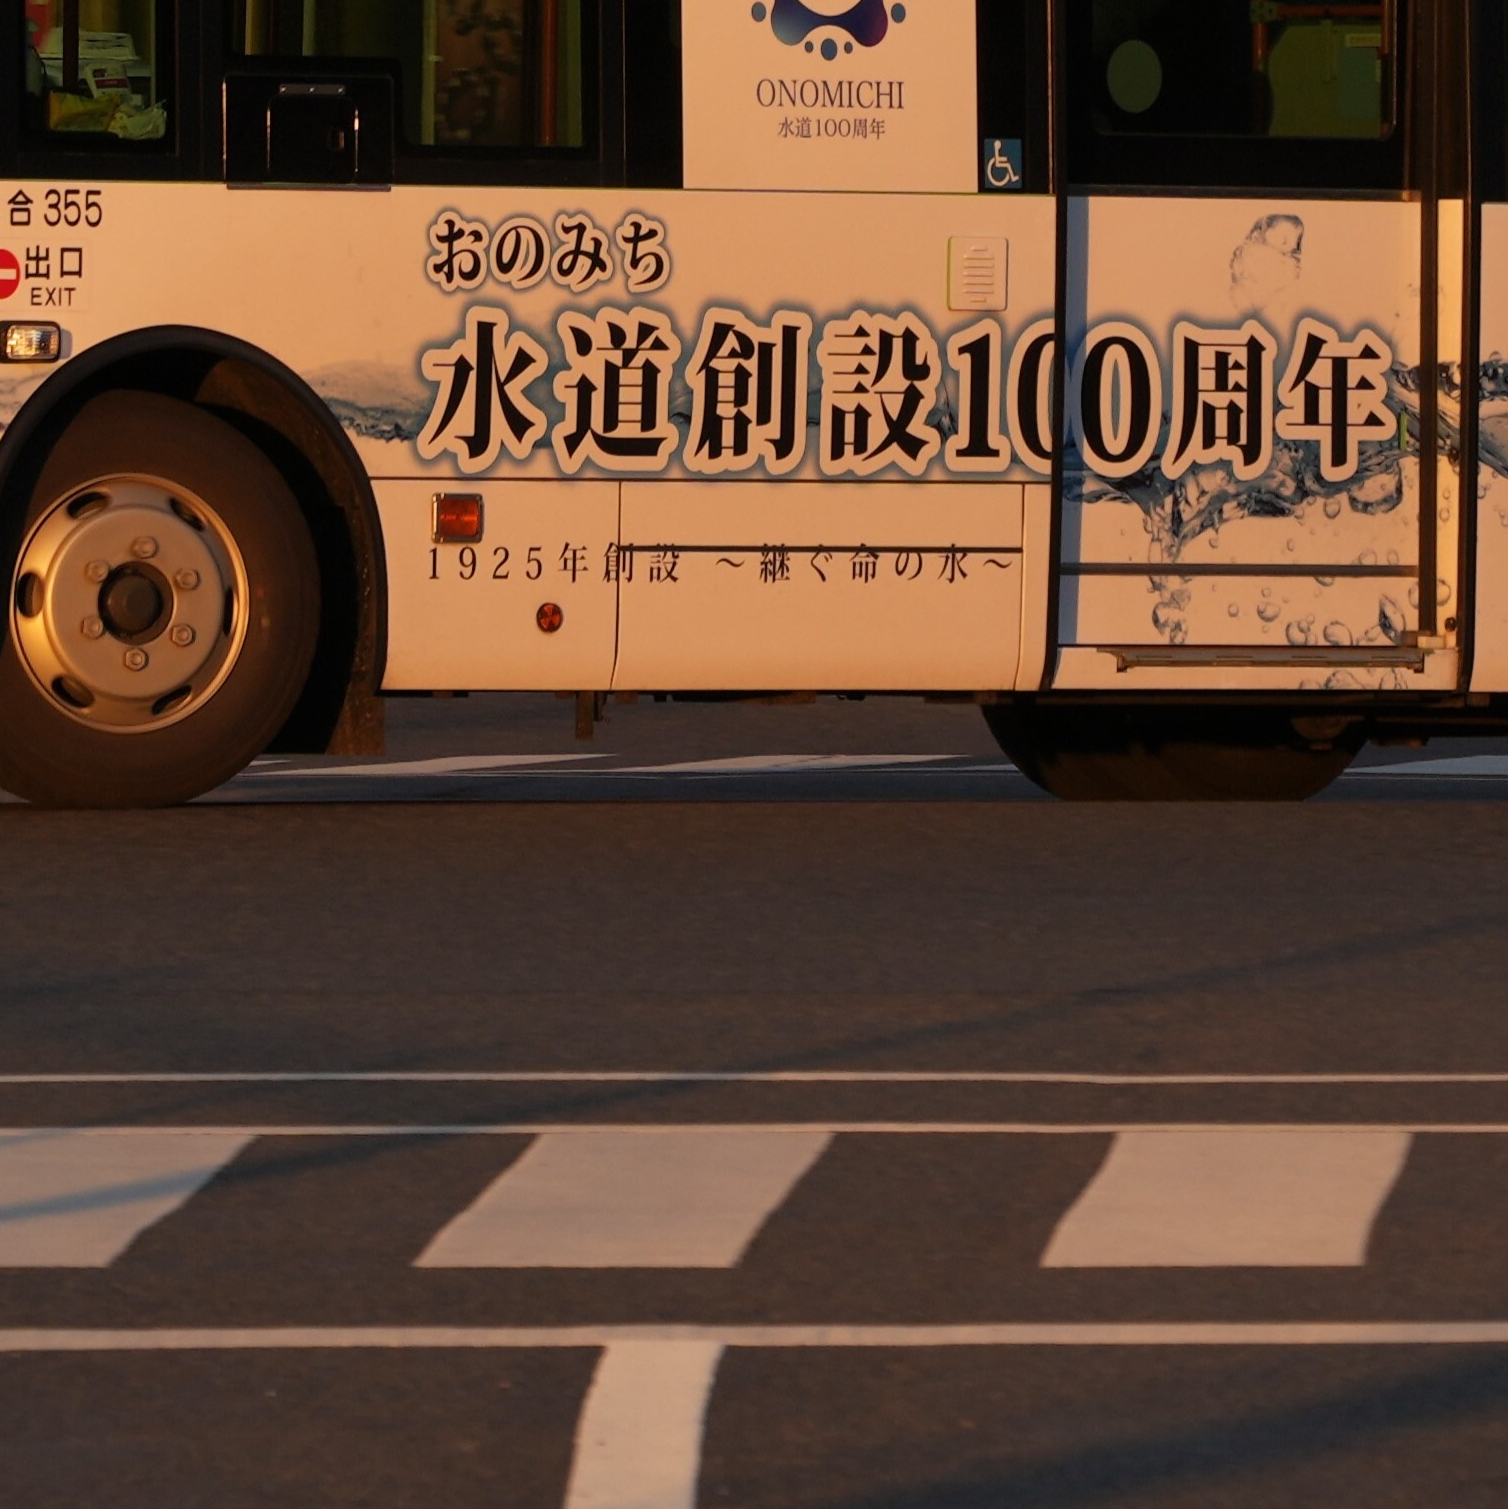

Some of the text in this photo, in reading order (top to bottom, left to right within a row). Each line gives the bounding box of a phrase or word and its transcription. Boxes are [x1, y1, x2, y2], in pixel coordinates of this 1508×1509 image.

[756, 79, 905, 109] ONOMICHI
[778, 117, 885, 140] 水道100周年
[25, 245, 83, 280] 出口
[429, 214, 671, 288] おのみち
[30, 287, 77, 306] EXIT
[428, 320, 1393, 474] 水道創設100周年
[428, 542, 680, 584] 1925年創設
